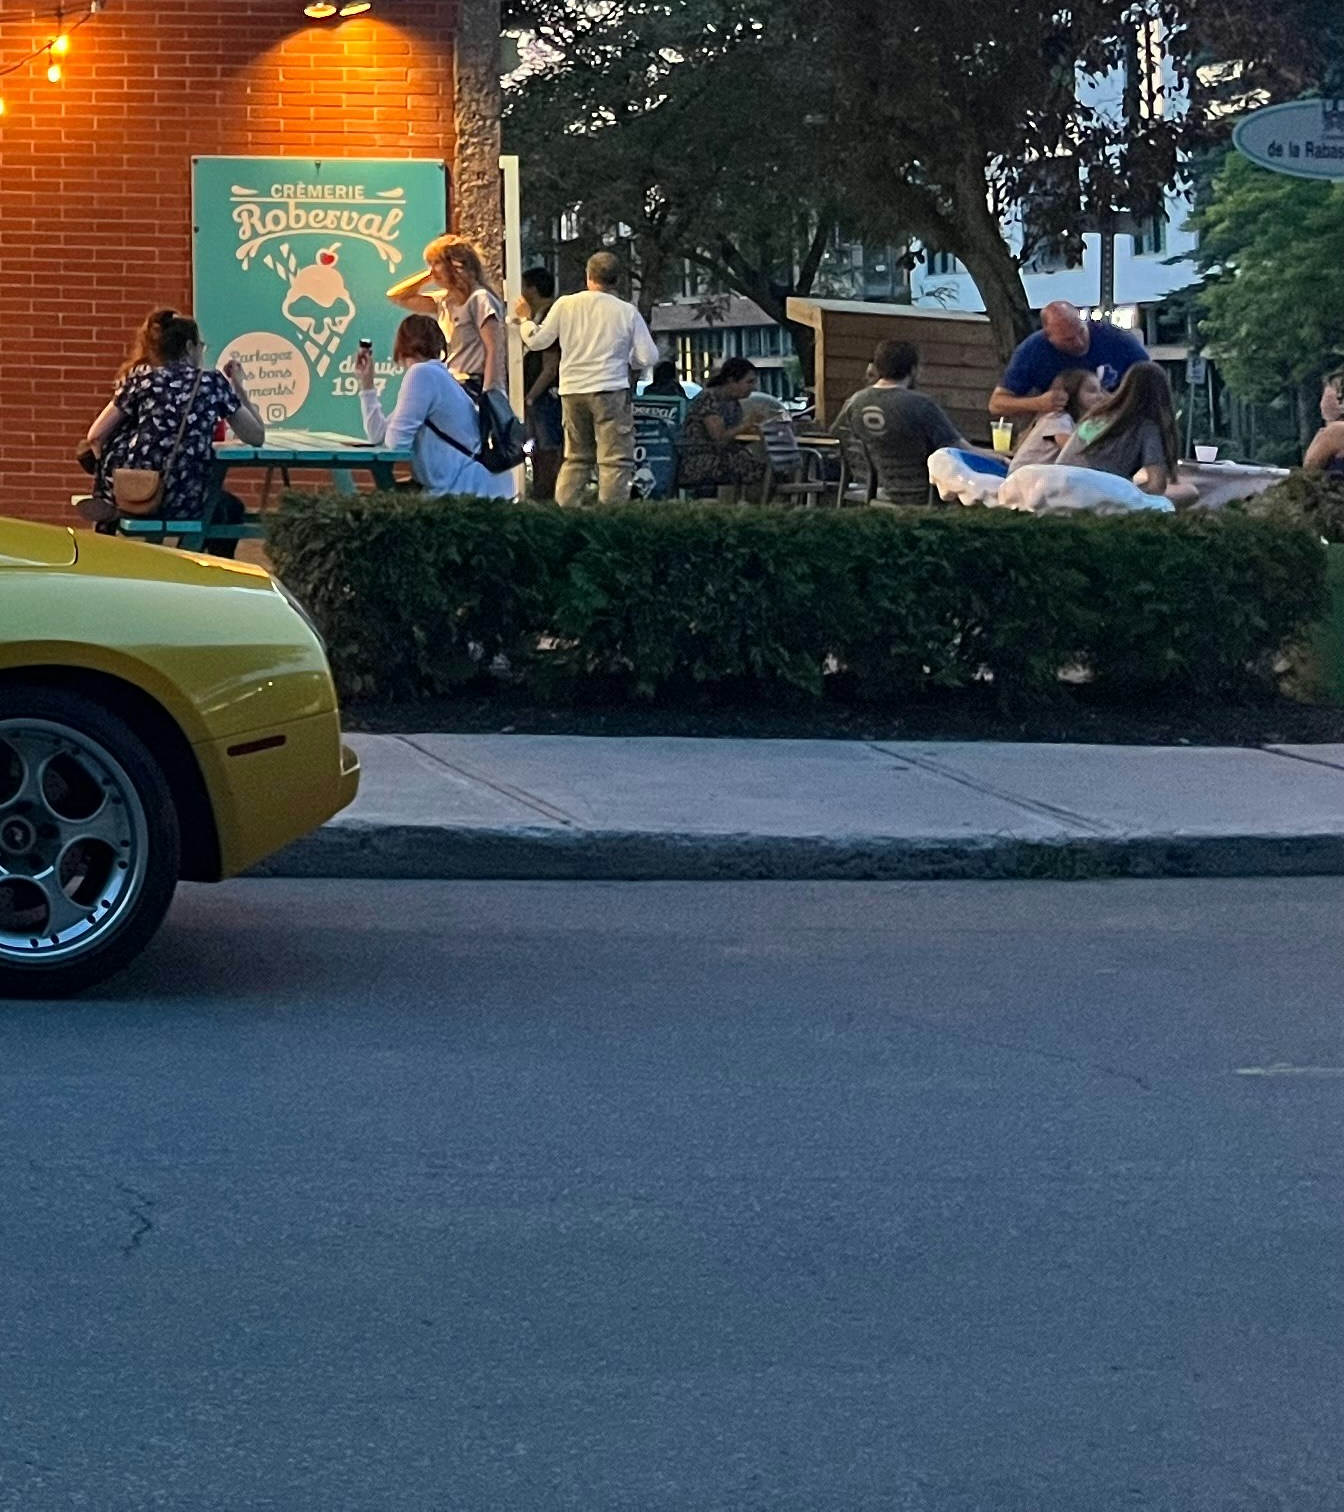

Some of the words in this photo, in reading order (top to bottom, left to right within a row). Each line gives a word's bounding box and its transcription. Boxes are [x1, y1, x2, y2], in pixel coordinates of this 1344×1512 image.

[1268, 140, 1283, 157] de
[1288, 141, 1300, 158] la
[270, 181, 365, 199] CRÈMERIE
[232, 201, 404, 241] Roberval
[230, 349, 293, 365] Partagez
[339, 355, 404, 376] duis
[259, 367, 291, 379] bons
[248, 379, 296, 397] ments!
[332, 377, 387, 397] 197
